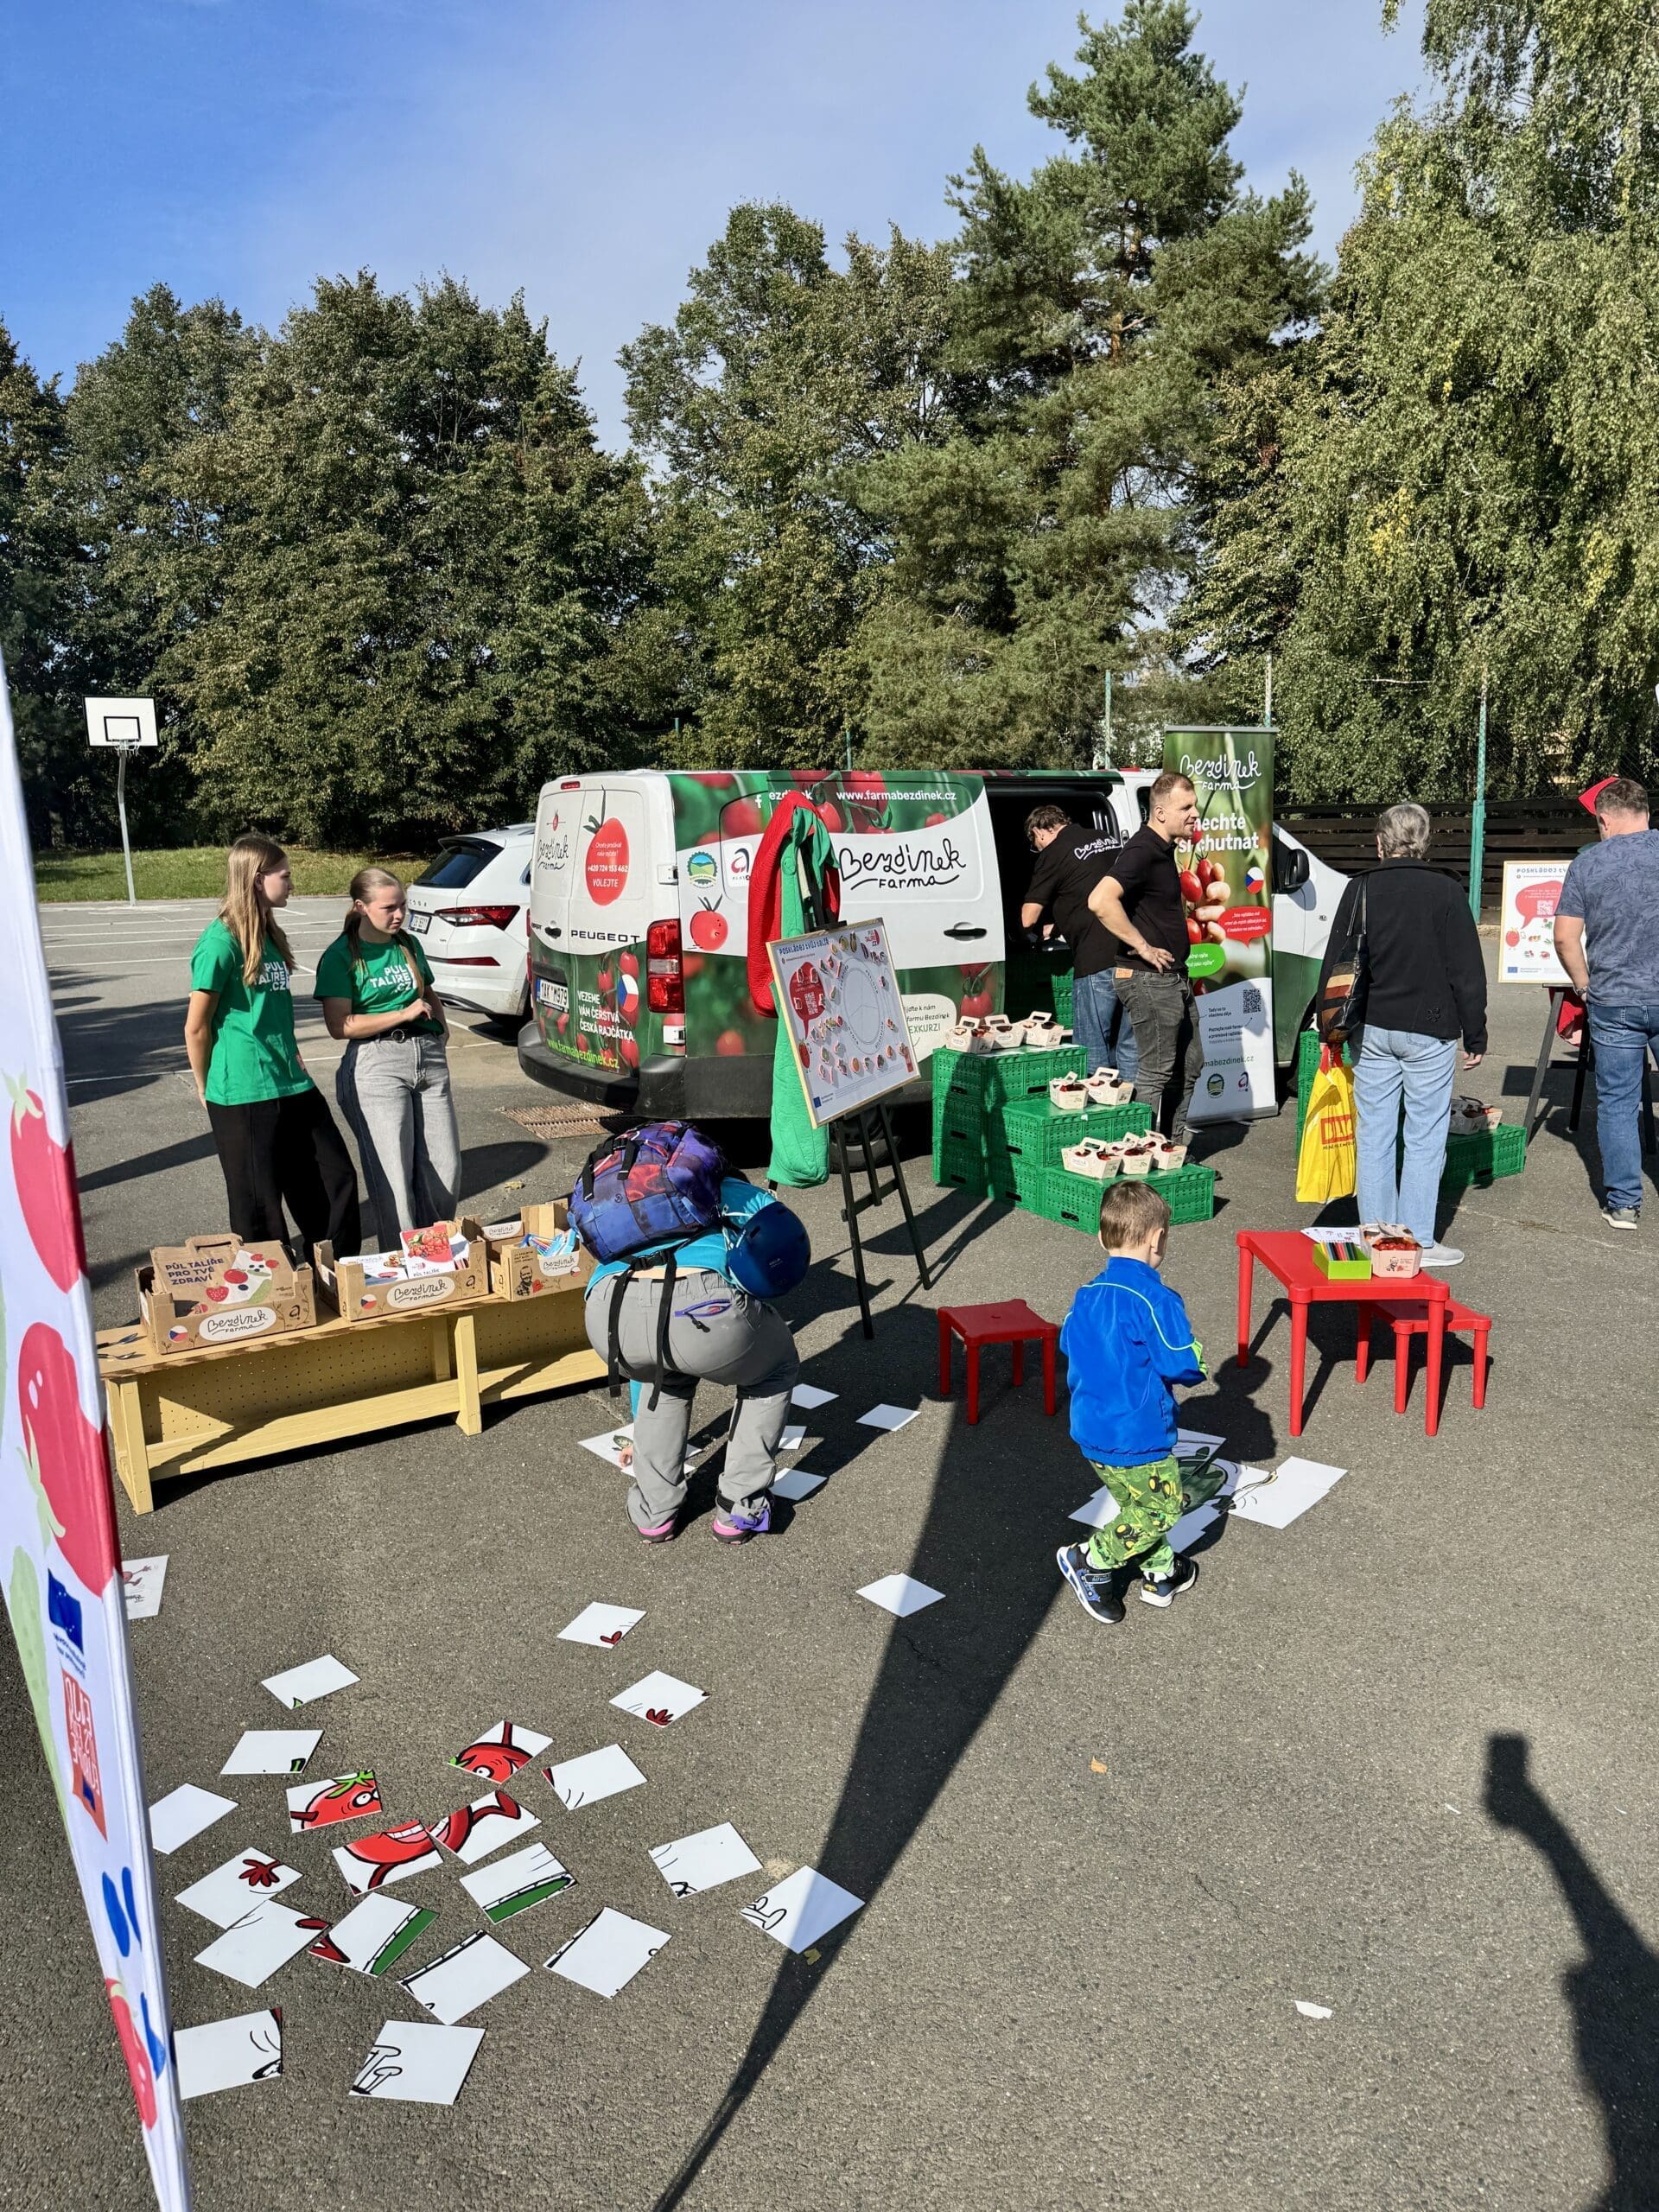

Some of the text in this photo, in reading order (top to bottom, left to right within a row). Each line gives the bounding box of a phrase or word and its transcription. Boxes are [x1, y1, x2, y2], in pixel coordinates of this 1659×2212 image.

[836, 789, 957, 801] www.farmabezdinek.cz
[1198, 831, 1259, 851] chutnat
[593, 878, 619, 887] VOLEJTE
[571, 930, 640, 944] PEUGEOT
[385, 963, 407, 977] PUL
[370, 970, 410, 988] TALIRE
[577, 990, 601, 1004] VEZEME
[578, 1005, 591, 1018] VÁM
[591, 1007, 620, 1024] ČERSTVÁ
[580, 1019, 598, 1033] ČESKÁ
[547, 1039, 620, 1069] www.farmabezdinek.cz
[165, 1257, 225, 1271] PŮL TALÍŘE
[168, 1265, 215, 1278] PRO TVÉ
[170, 1274, 213, 1286] ZDRAVÍ
